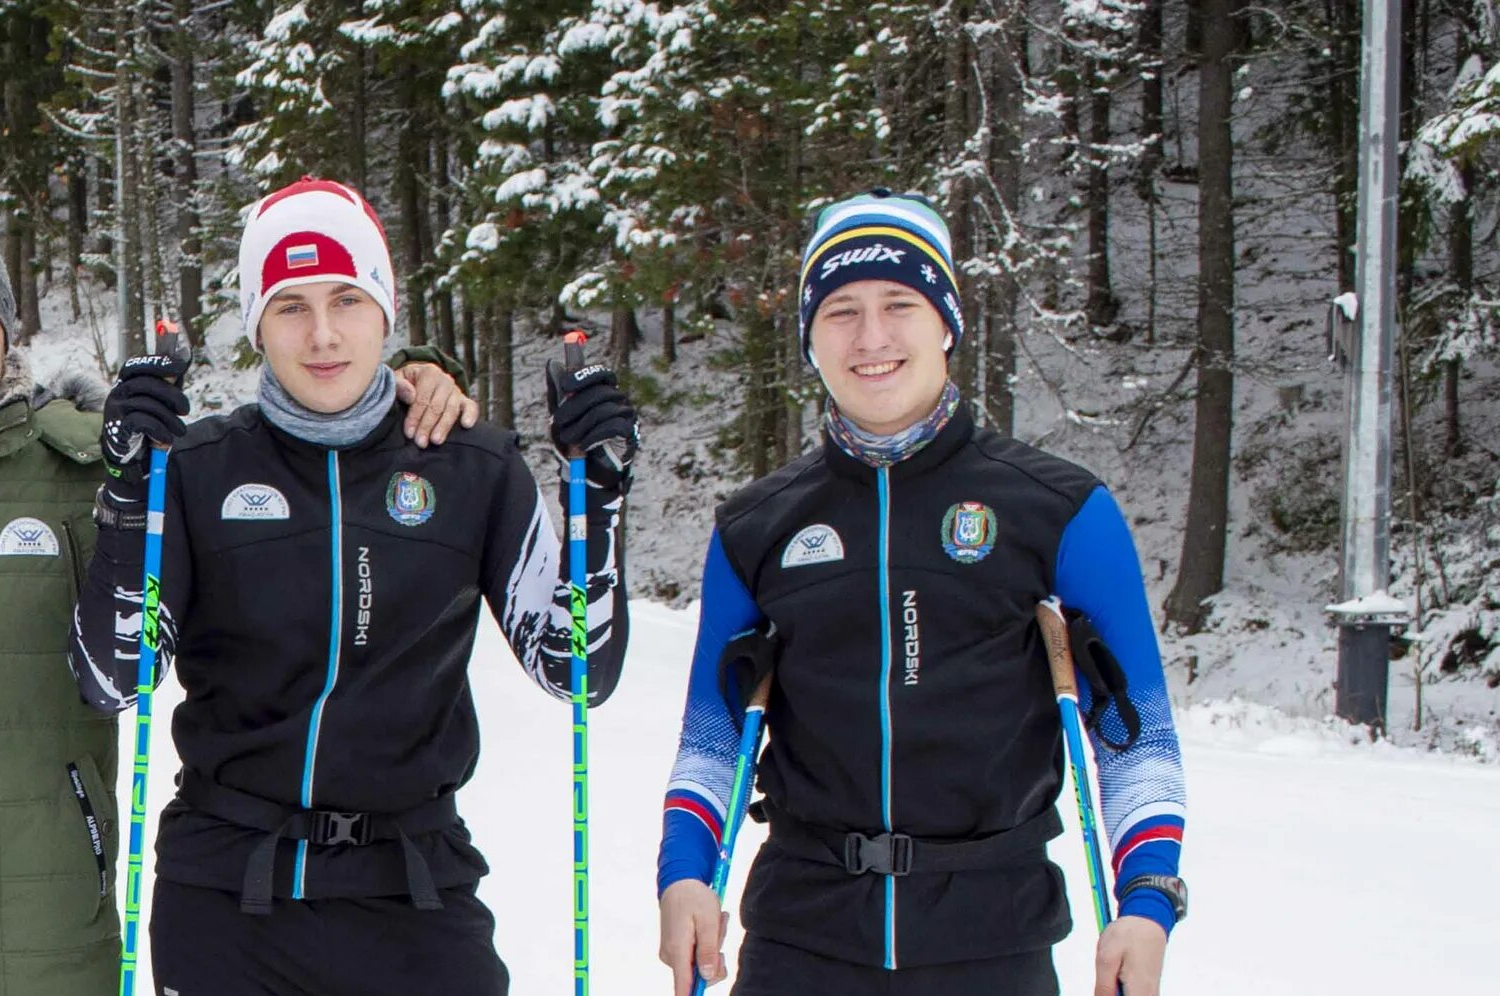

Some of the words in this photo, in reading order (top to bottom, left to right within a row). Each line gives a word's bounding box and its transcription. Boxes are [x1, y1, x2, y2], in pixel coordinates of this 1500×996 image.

[125, 355, 162, 367] CRAFT
[355, 547, 372, 645] NORDSKI
[903, 590, 919, 686] NORDSKI
